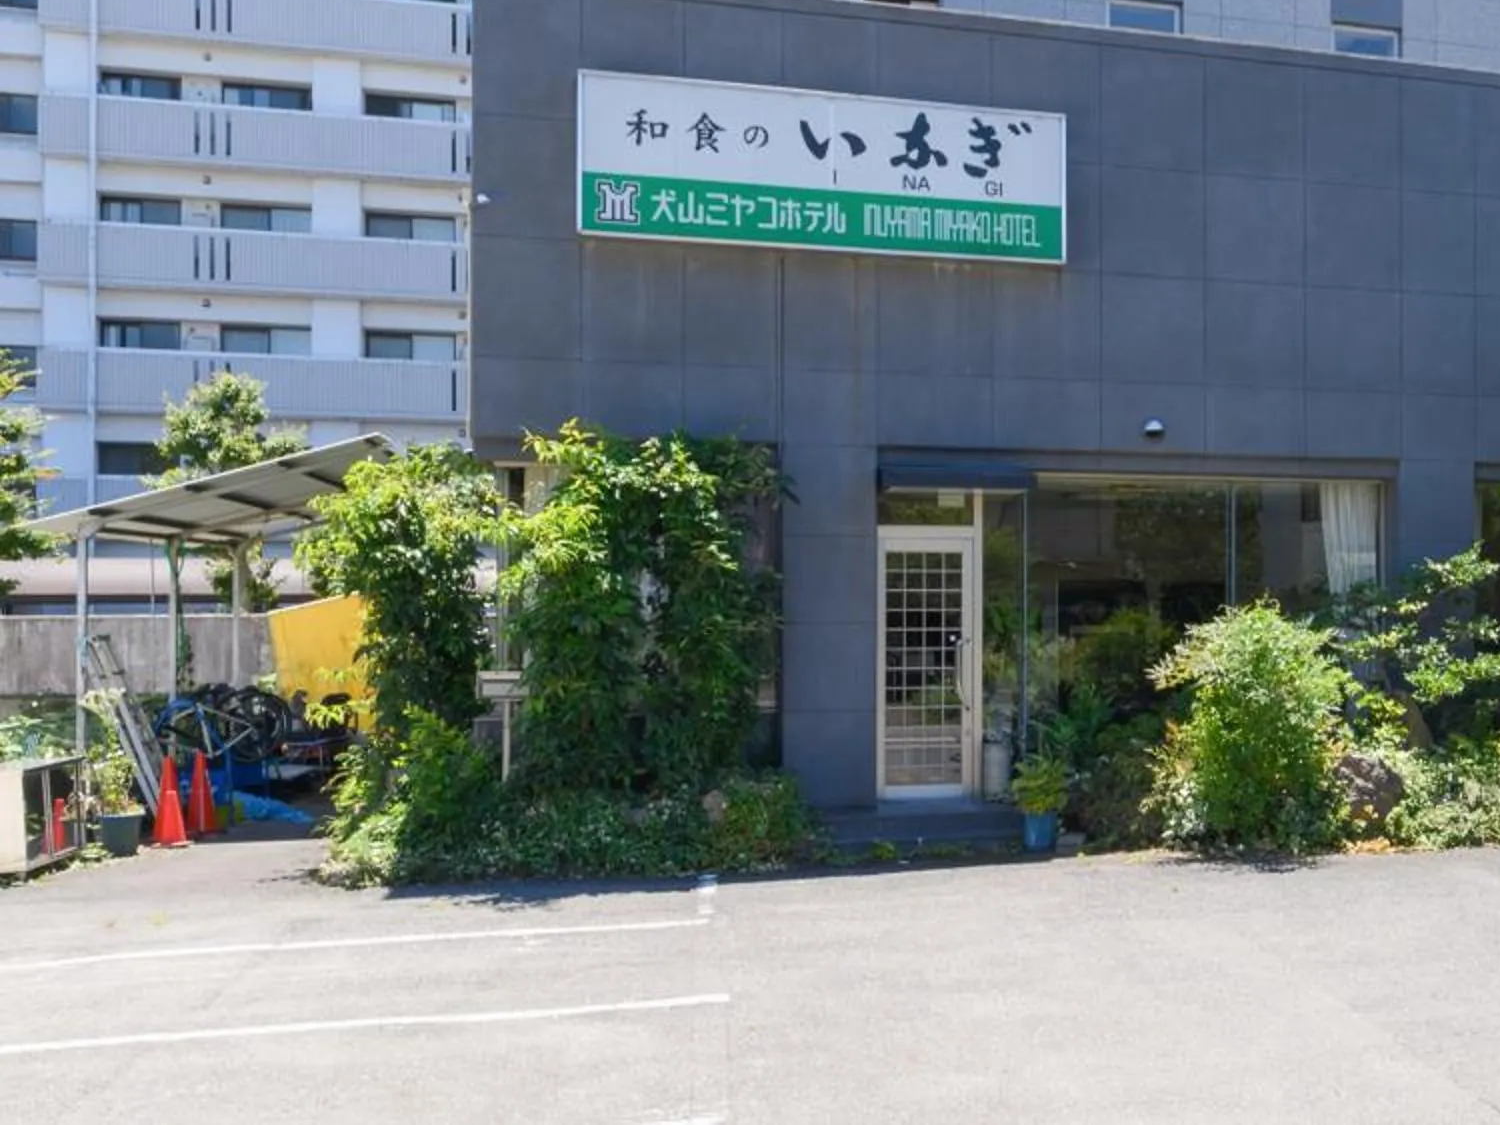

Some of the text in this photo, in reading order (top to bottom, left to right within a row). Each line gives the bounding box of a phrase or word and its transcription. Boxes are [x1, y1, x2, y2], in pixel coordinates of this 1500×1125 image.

[626, 109, 769, 154] 和食の
[902, 174, 931, 193] NA
[985, 180, 1004, 197] GI
[649, 192, 847, 236] 犬山ミヤコホテル
[863, 203, 1041, 247] INUYAMA MIYAKO HOTEL
